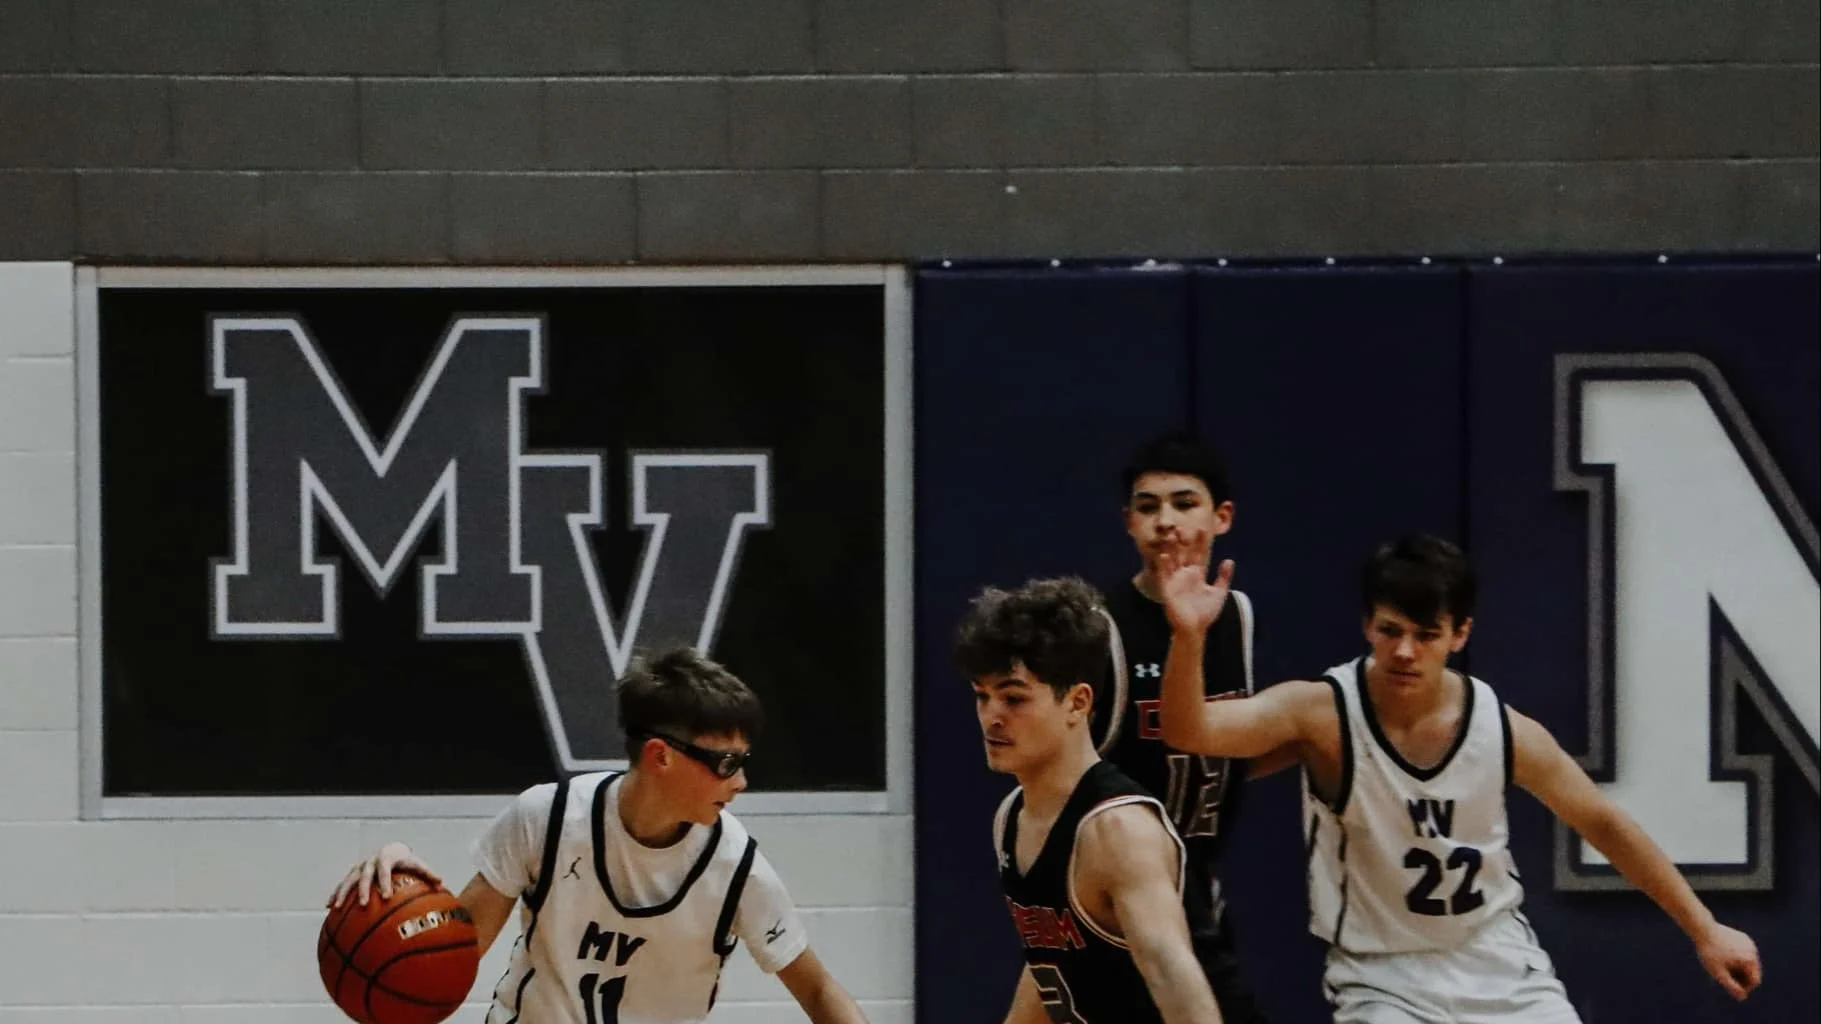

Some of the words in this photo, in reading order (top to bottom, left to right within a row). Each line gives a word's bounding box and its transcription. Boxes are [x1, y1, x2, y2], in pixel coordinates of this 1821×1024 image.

[210, 315, 771, 772] MV
[1407, 799, 1454, 838] MV
[1404, 847, 1485, 916] 22
[577, 921, 648, 966] MV
